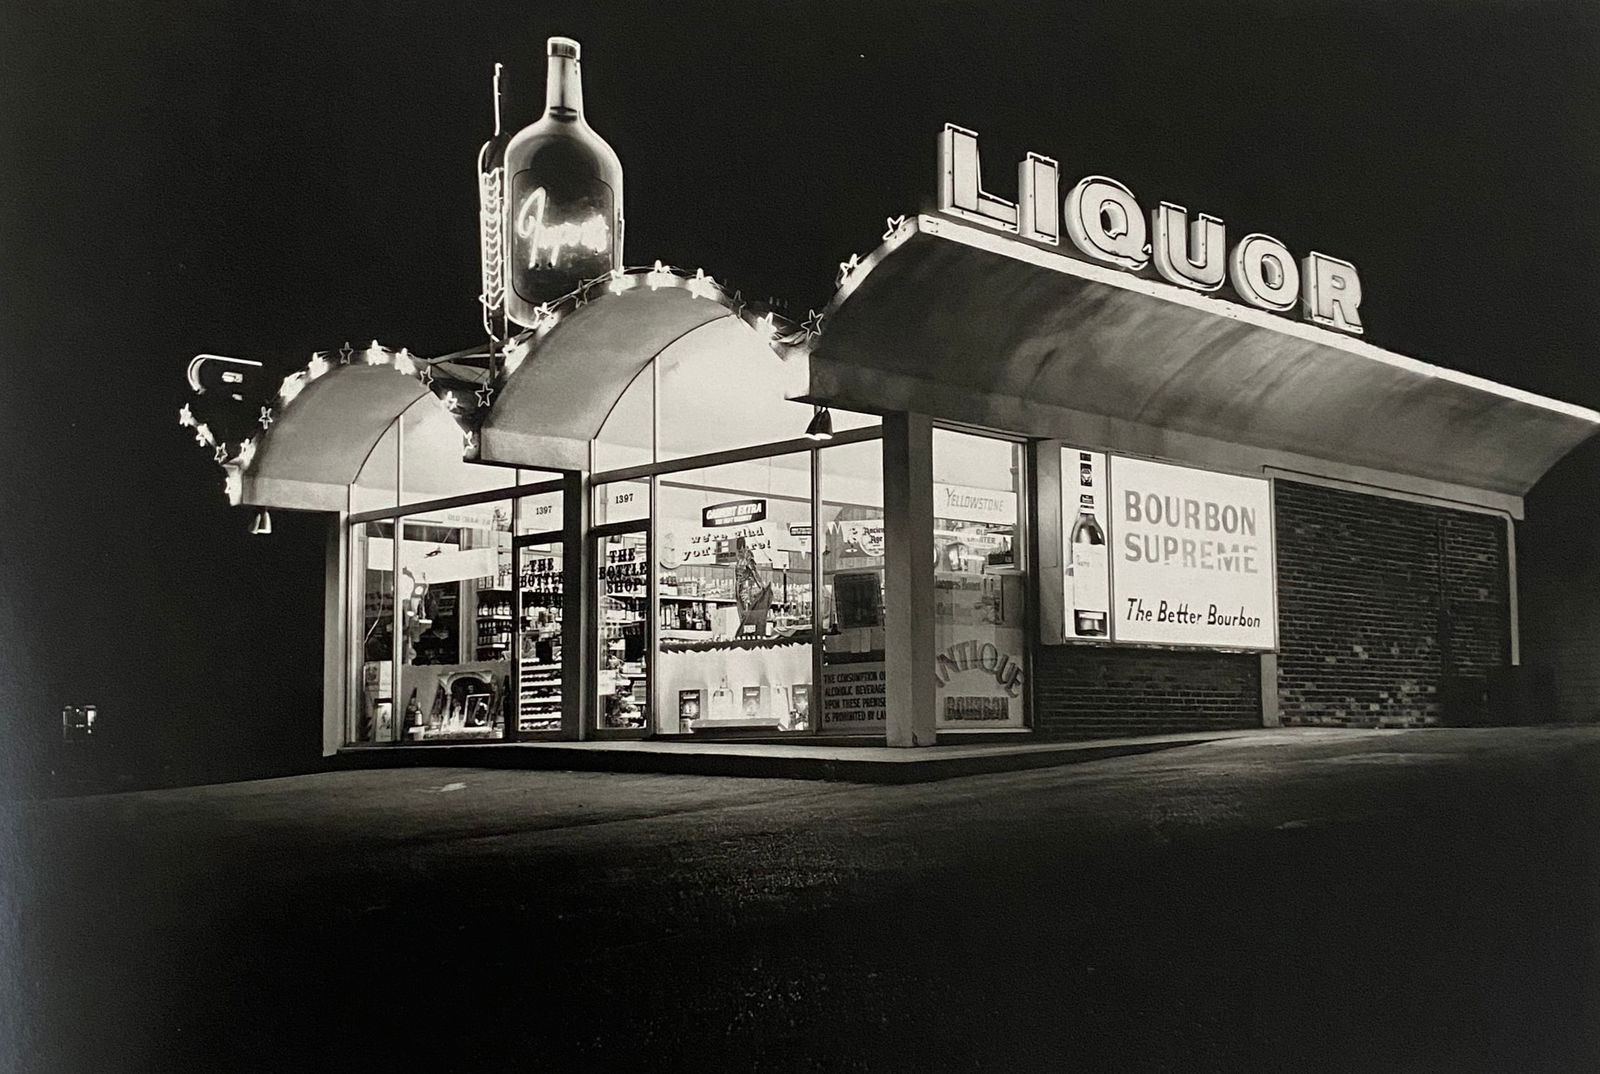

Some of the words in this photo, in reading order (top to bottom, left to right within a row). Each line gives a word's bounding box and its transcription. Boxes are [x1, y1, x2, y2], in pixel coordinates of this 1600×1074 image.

[938, 122, 1364, 334] LIQUOR
[615, 493, 634, 504] 1397
[535, 505, 553, 516] 1397
[1124, 490, 1256, 537] BOURBON
[609, 548, 636, 563] THE
[1125, 532, 1258, 574] SUPREME
[529, 558, 554, 572] THE
[599, 562, 648, 580] BOTTLE
[607, 578, 642, 594] SHOP
[1127, 598, 1152, 622] The
[1158, 600, 1202, 625] Better
[1207, 604, 1261, 628] Bourbon
[935, 640, 1024, 698] NTIQUE
[824, 674, 836, 684] THE
[842, 698, 860, 708] THESE
[825, 712, 830, 722] IS
[832, 711, 866, 722] PROHIBITED
